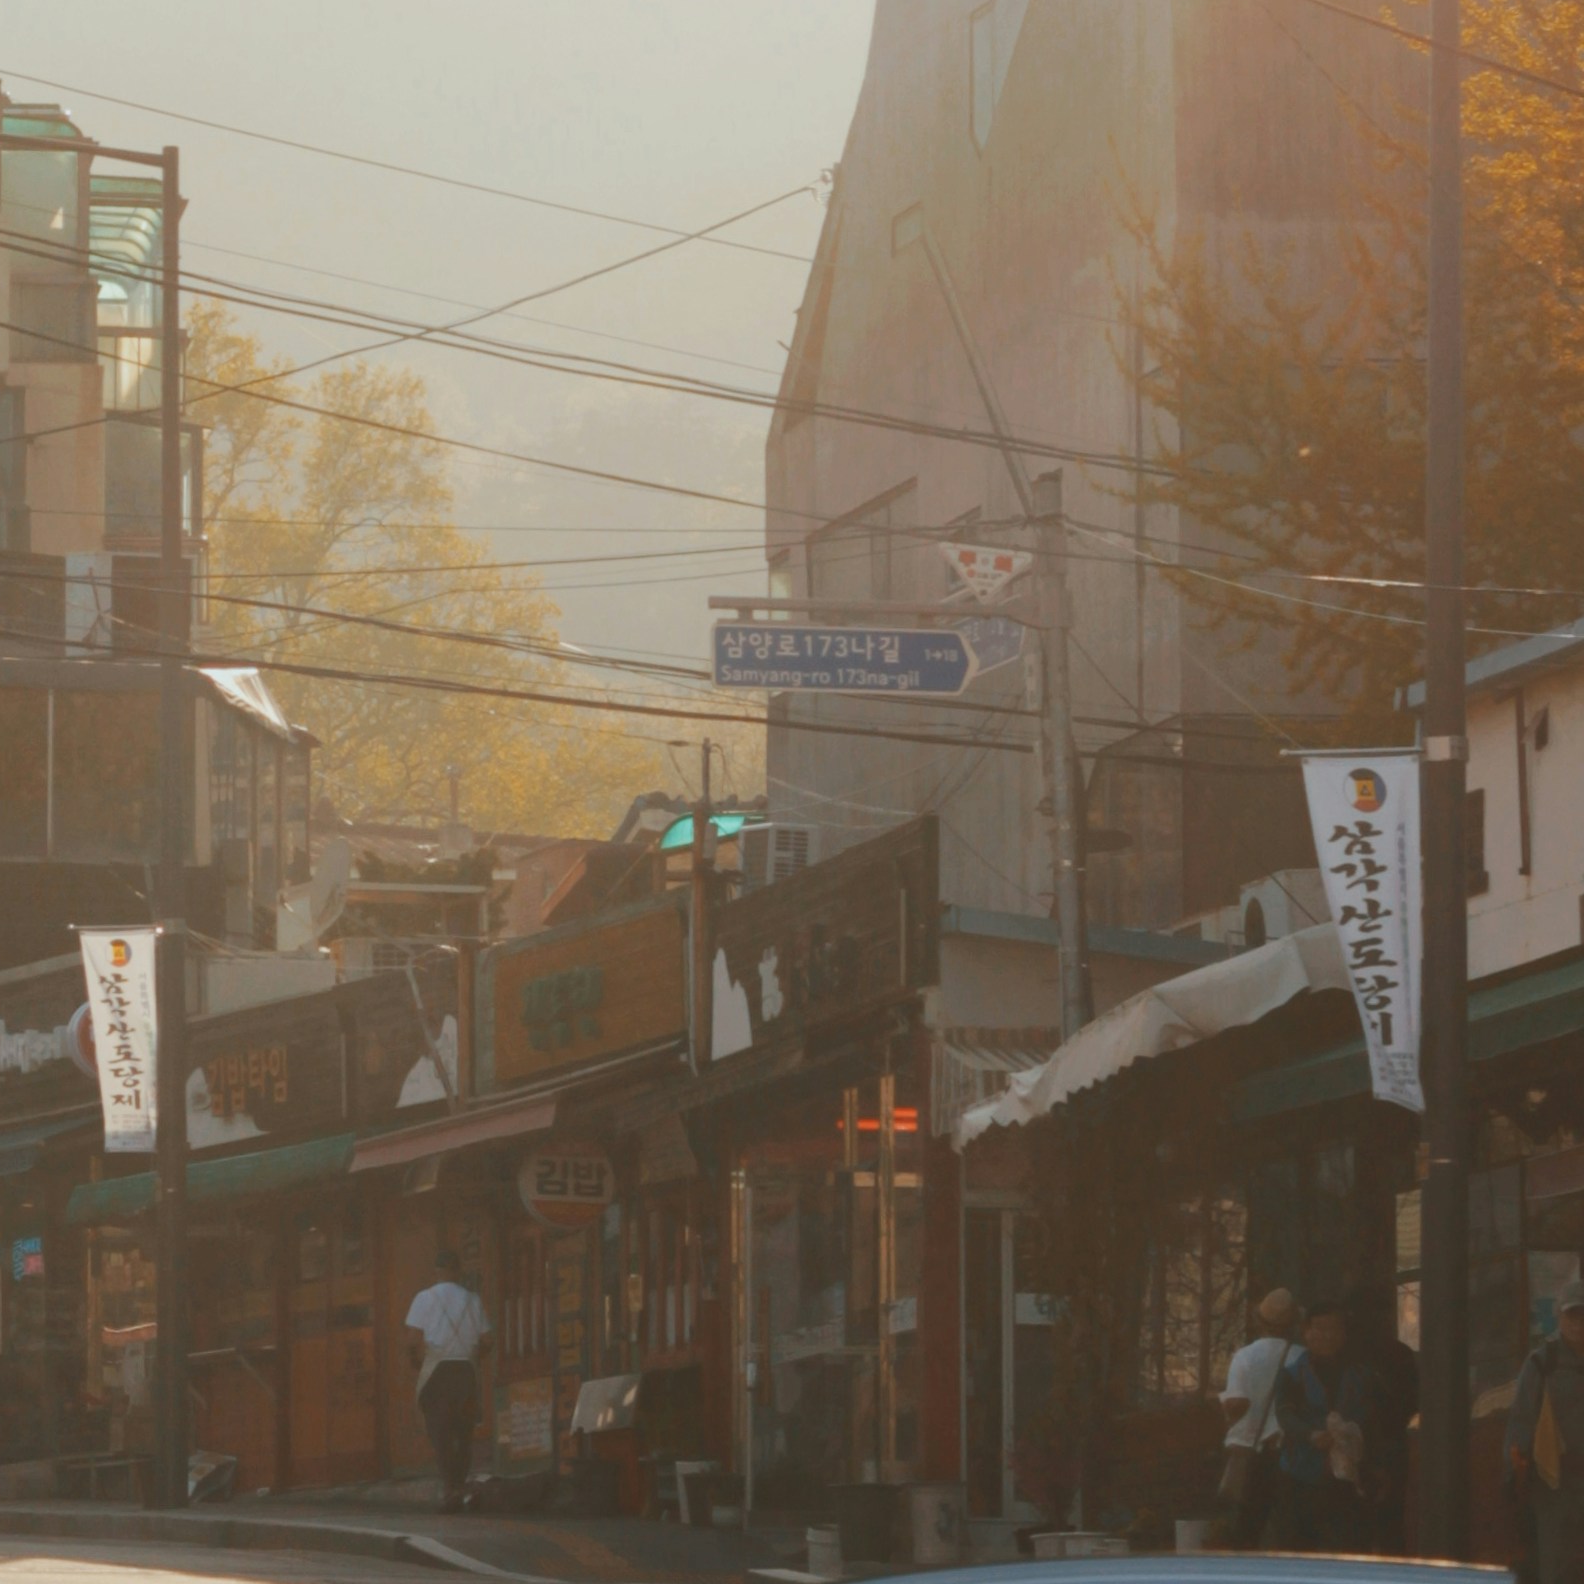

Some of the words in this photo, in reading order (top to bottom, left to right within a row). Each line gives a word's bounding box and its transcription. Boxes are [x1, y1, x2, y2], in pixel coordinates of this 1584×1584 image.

[721, 665, 831, 688] Samyang-ro
[98, 973, 145, 1110] 삼각산도당제
[536, 1159, 607, 1197] 김밥
